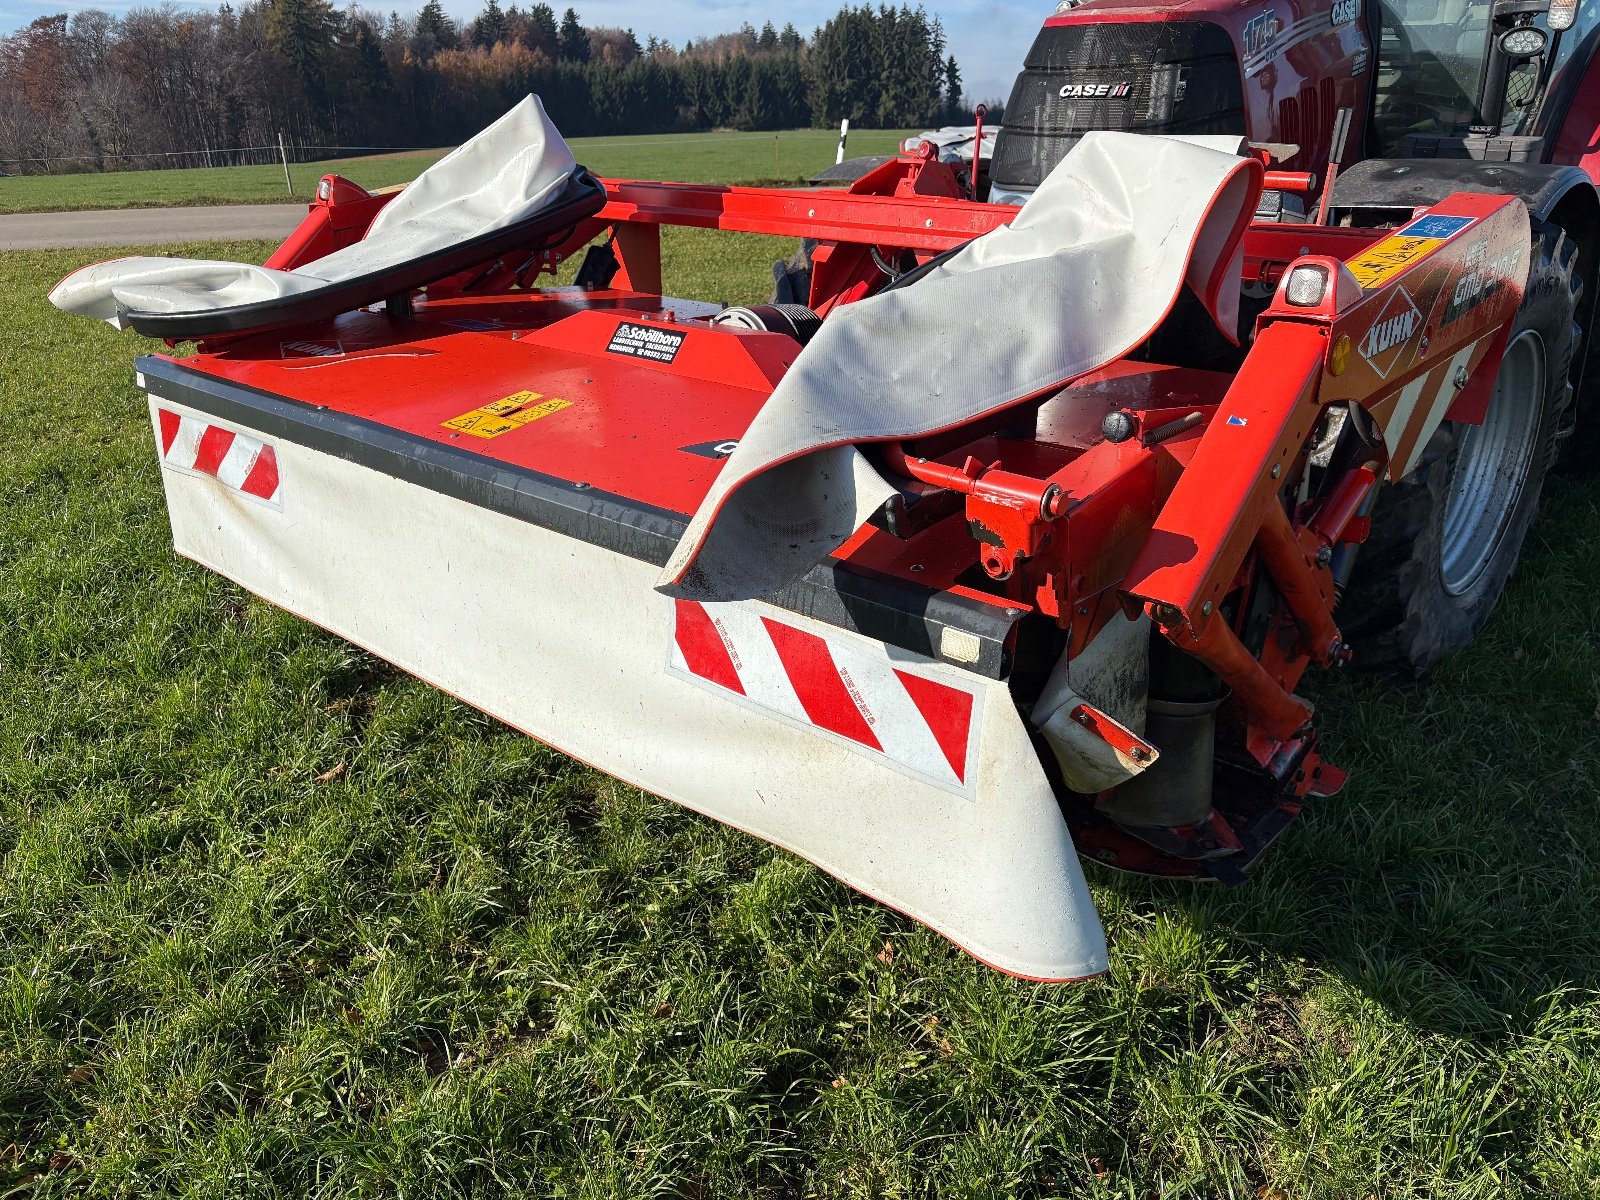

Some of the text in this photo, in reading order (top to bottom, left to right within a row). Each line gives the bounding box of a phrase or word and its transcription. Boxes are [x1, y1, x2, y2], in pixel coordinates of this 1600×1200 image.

[1331, 0, 1356, 25] CASE
[1060, 84, 1109, 98] CASE
[629, 327, 682, 347] Schöllhorn
[1366, 308, 1416, 359] KUHN
